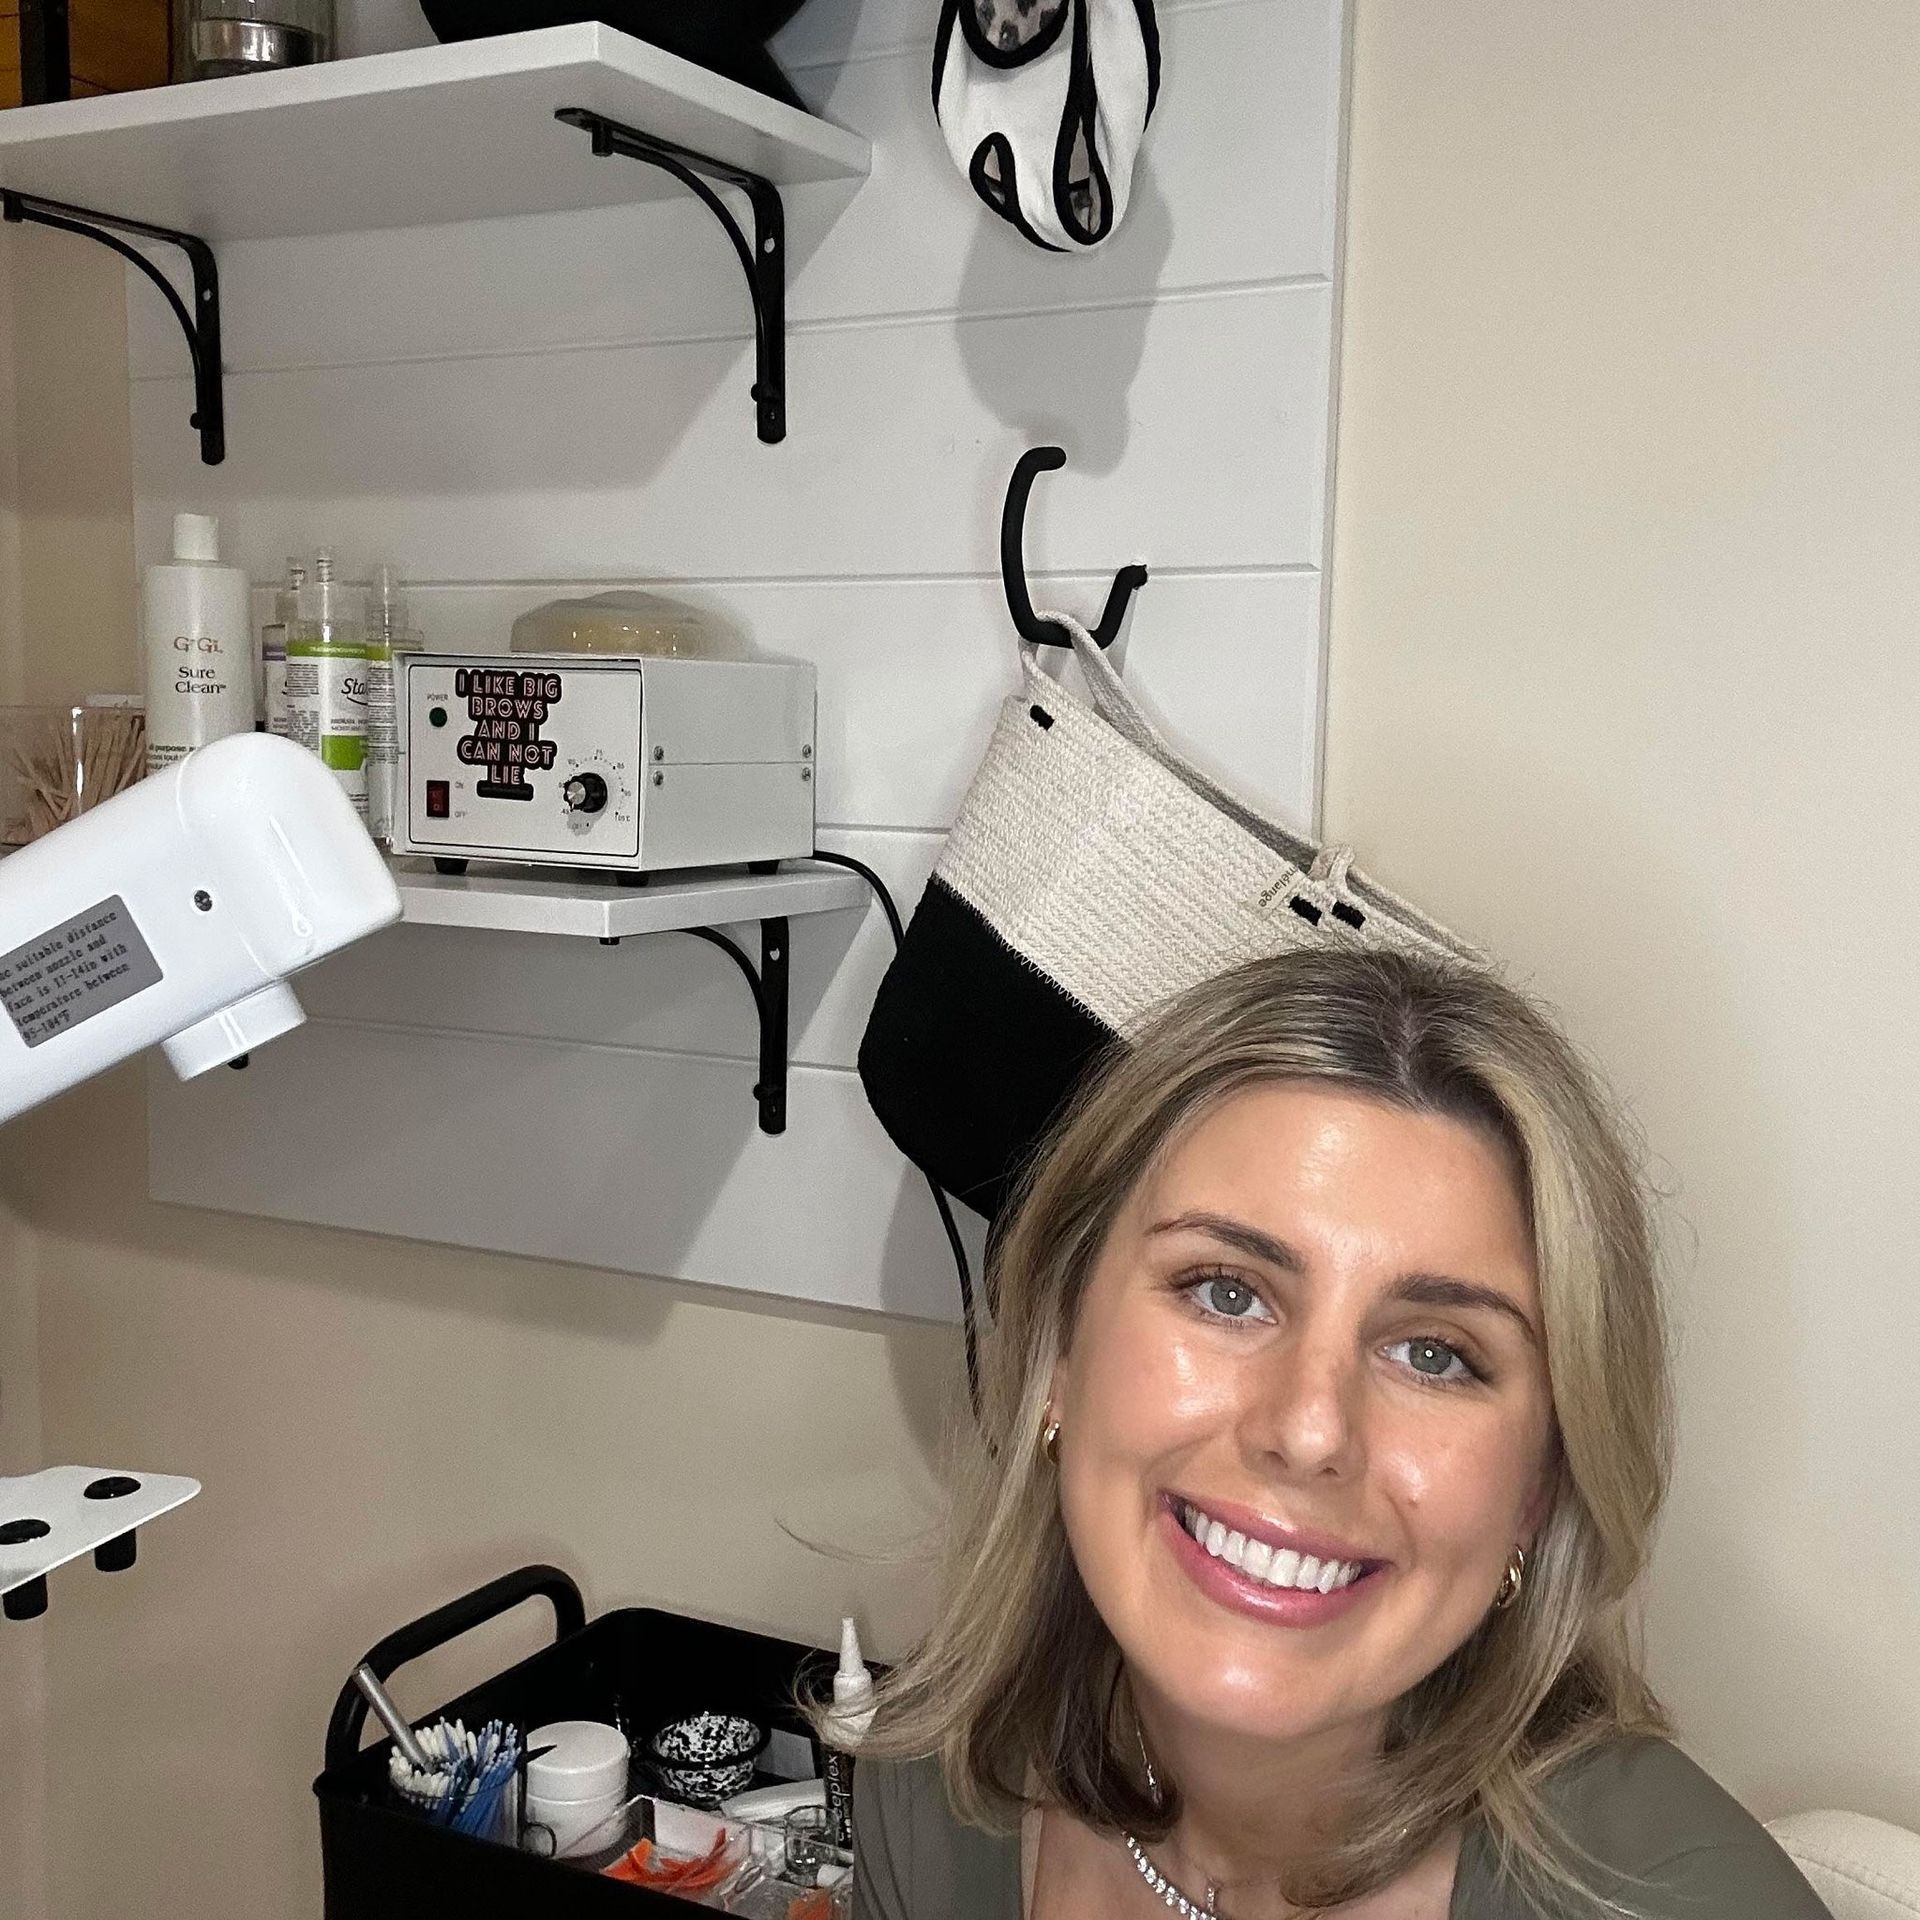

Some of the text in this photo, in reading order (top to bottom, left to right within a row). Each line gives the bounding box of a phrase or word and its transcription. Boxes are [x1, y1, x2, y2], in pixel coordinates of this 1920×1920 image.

[173, 636, 223, 654] GGi
[179, 666, 215, 679] Sure
[341, 678, 368, 695] Sta
[427, 693, 448, 701] POWER
[459, 673, 558, 698] I LIKE BIG
[472, 696, 544, 719] BROWS
[478, 719, 535, 741] AND I
[461, 740, 553, 765] CAN NOT
[491, 765, 520, 785] LIE
[15, 940, 64, 972] suitable
[66, 911, 118, 944] distance
[0, 934, 107, 999] between nozzle and
[6, 995, 34, 1013] face
[36, 985, 50, 997] is
[100, 943, 128, 963] with
[16, 963, 131, 1027] temperature between
